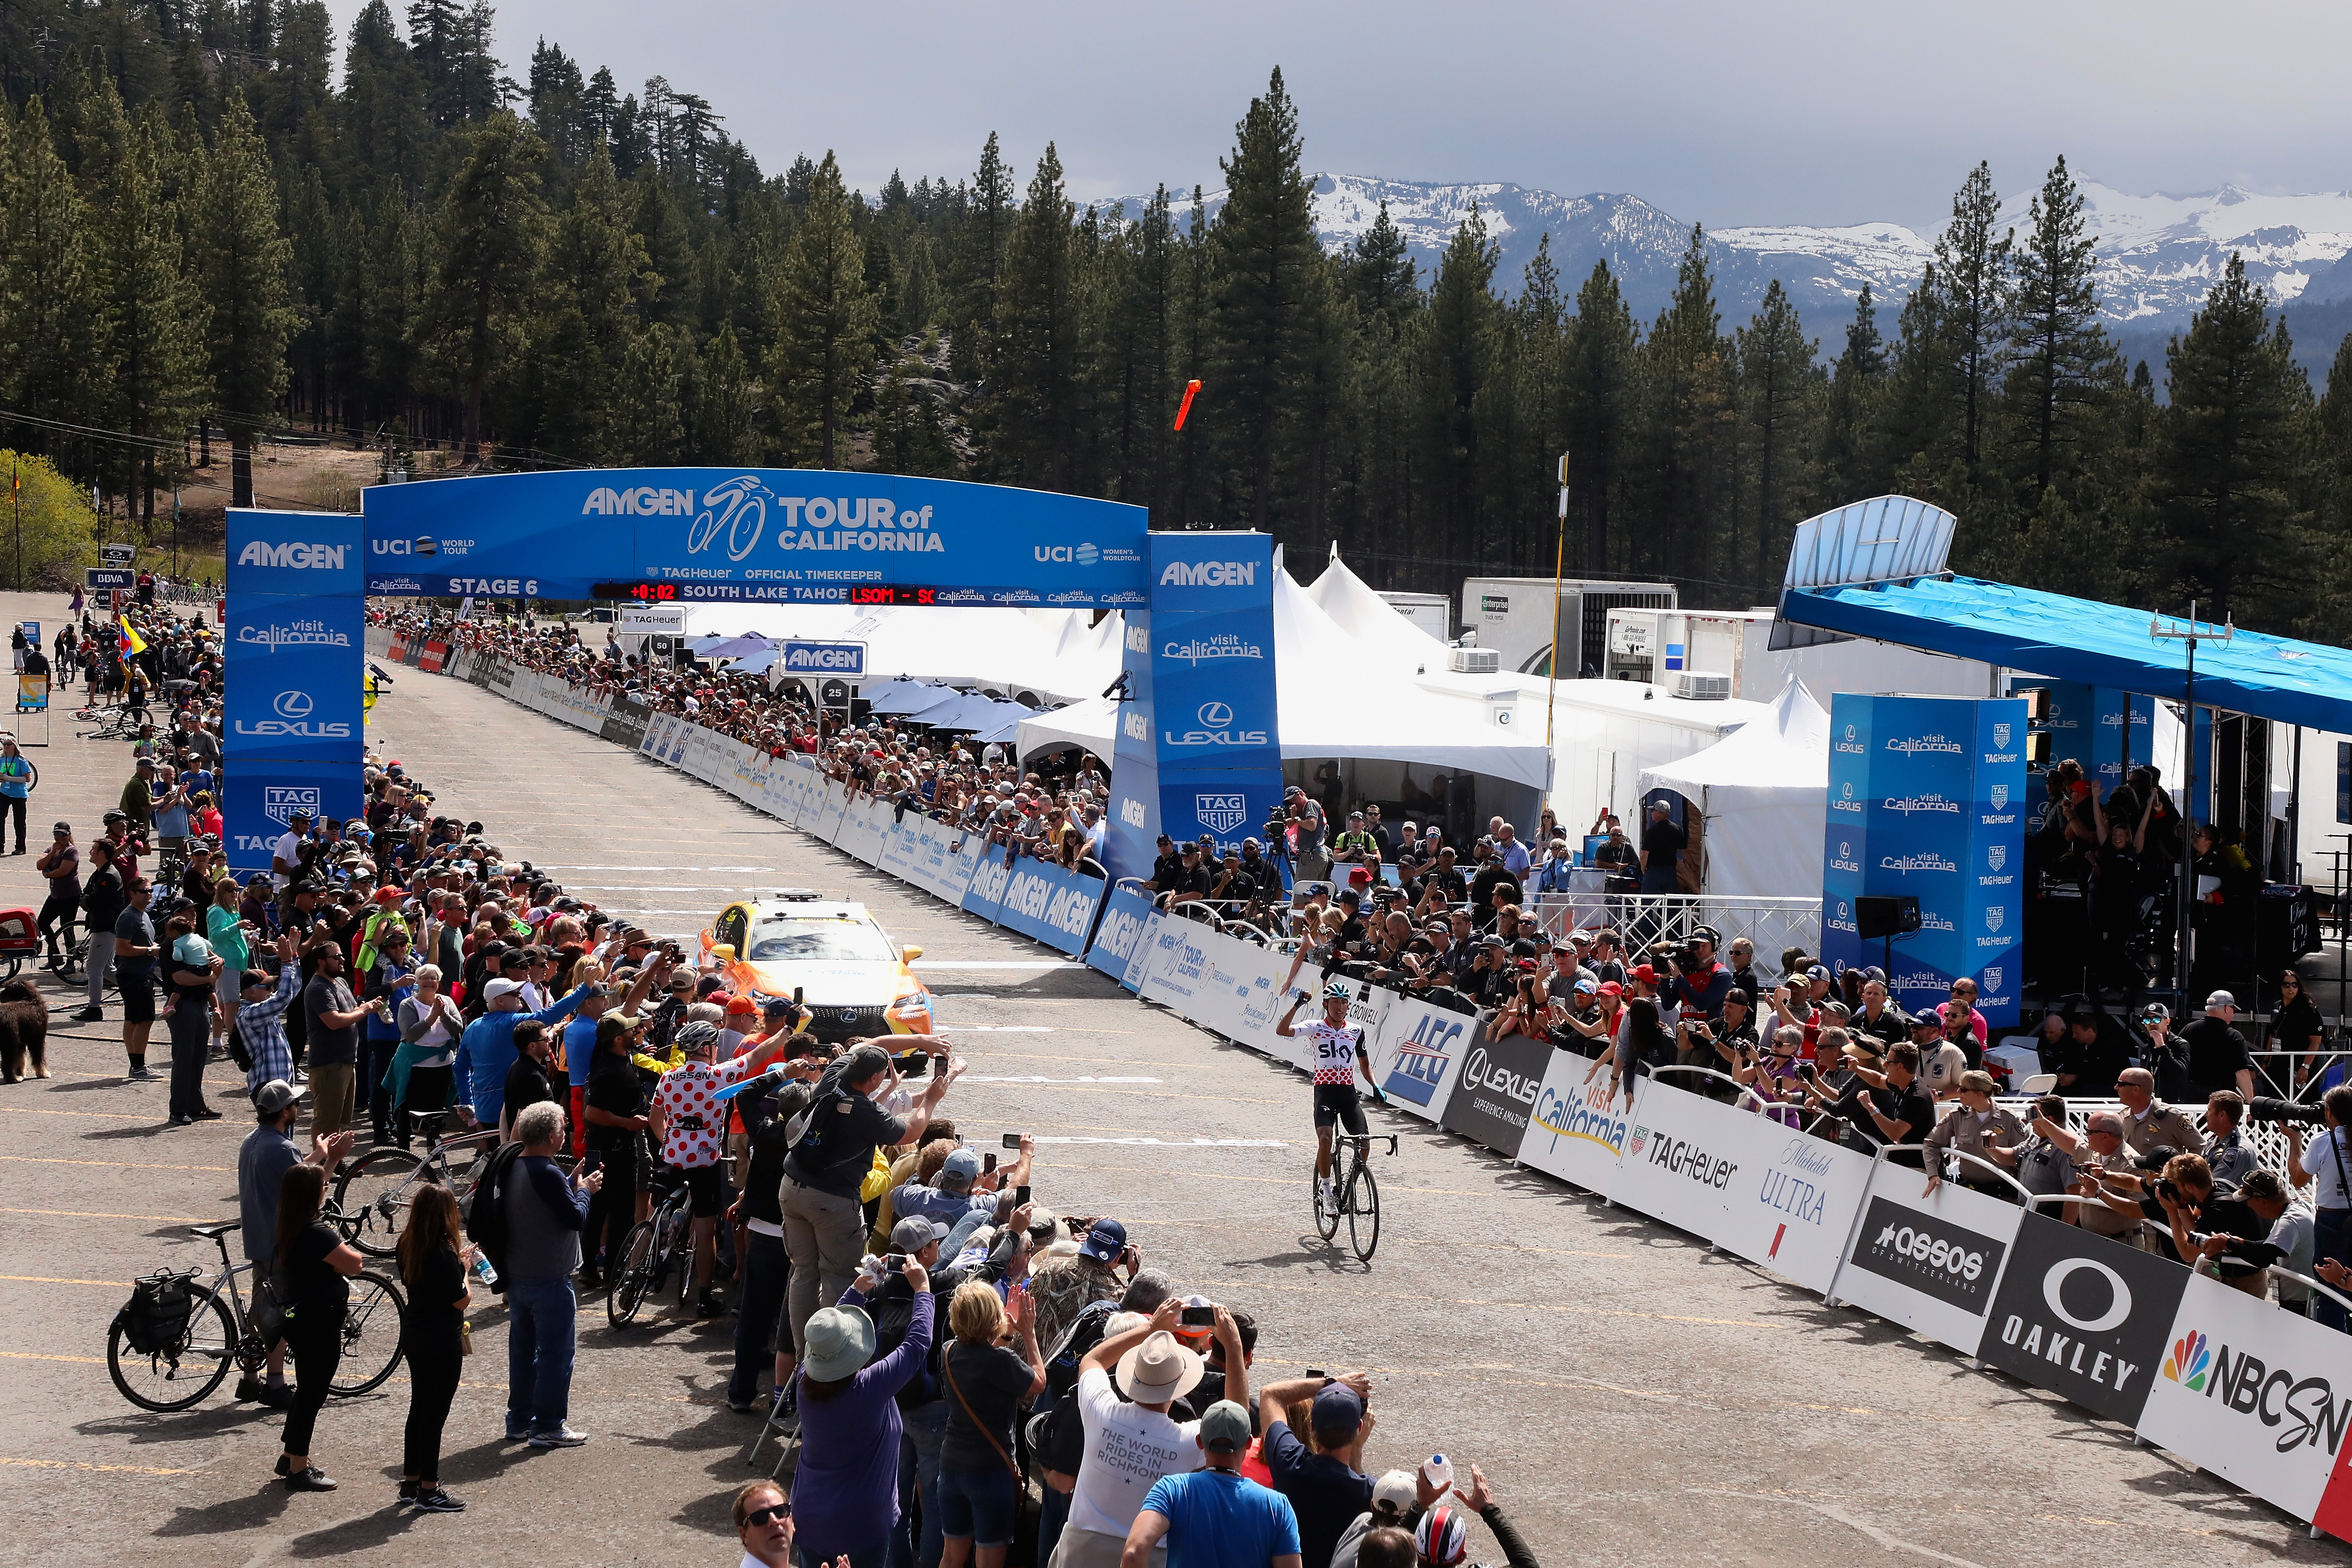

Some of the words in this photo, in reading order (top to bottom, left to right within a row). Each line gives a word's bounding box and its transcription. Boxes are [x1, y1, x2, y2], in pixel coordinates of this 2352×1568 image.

[582, 487, 693, 516] AMGEN
[779, 497, 895, 528] TOUR
[900, 505, 933, 529] of
[373, 539, 411, 555] UCI
[778, 530, 945, 552] CALIFORNIA
[238, 541, 344, 569] AMGEN
[1034, 546, 1072, 562] UCI
[98, 575, 124, 583] BBVA
[662, 567, 732, 578] TAGHeuer
[745, 570, 802, 579] OFFICIAL
[805, 570, 882, 580] TIMEKEEPER
[1160, 561, 1254, 586] AMGEN
[370, 580, 421, 593] California
[449, 578, 519, 594] STAGE
[525, 580, 537, 595] 6
[631, 585, 674, 599] +0:02
[684, 585, 739, 598] SOUTH
[746, 587, 788, 599] LAKE
[794, 587, 847, 599] TAHOE
[852, 587, 894, 603] LSOM
[937, 592, 985, 604] California
[992, 592, 1040, 605] California
[1047, 592, 1094, 605] California
[1100, 594, 1145, 606] California
[1482, 599, 1508, 610] enterprise
[292, 620, 323, 632] visit
[237, 624, 351, 653] California
[1126, 626, 1148, 654] AMGEN
[1210, 634, 1239, 645] visit
[788, 649, 857, 668] AMGEN
[1162, 639, 1263, 666] California
[828, 689, 842, 697] 25
[235, 720, 350, 737] LEXUS
[1124, 711, 1147, 741] AMGEN
[2101, 713, 2148, 729] Califrnia
[1996, 725, 2008, 734] TAG
[1165, 731, 1268, 745] LEXUS
[1923, 734, 1944, 743] visit
[1995, 735, 2009, 748] HEUER
[1835, 742, 1864, 754] LEXUS
[1885, 737, 1963, 757] California
[1984, 753, 2017, 763] TAGHeuer
[270, 790, 314, 803] TAG
[1920, 794, 1942, 802] visit
[1993, 786, 2007, 794] TAG
[1200, 797, 1240, 809] TAG
[1833, 800, 1861, 812] LEXUS
[1883, 796, 1960, 817] California
[1992, 796, 2007, 809] HEUER
[1121, 797, 1145, 829] AMGEN
[1201, 811, 1243, 830] HEUER
[1981, 814, 2015, 825] TAGHeuer
[1917, 852, 1939, 861] visit
[1989, 857, 2005, 870] HEUER
[1830, 859, 1858, 872] LEXUS
[1880, 855, 1957, 875] California
[968, 859, 1010, 904] AMGEN
[1979, 875, 2013, 886] TAGHeuer
[1004, 871, 1051, 920] AMGEN
[1045, 886, 1094, 937] AMGEN
[1921, 912, 1937, 920] isit
[1988, 909, 2002, 917] TAG
[1828, 918, 1856, 932] LEXUS
[1987, 918, 2002, 931] HEUER
[1094, 908, 1141, 960] AMGEN
[1157, 933, 1176, 951] AMGEN
[1976, 936, 2012, 947] TAGHeuer
[1182, 945, 1202, 966] TOUR
[1199, 955, 1207, 968] of
[1212, 969, 1236, 987] BREAKAWAY
[1254, 976, 1271, 990] AMGEN
[1890, 974, 1951, 995] alifornia
[1913, 972, 1935, 981] visit
[1236, 985, 1250, 998] AMGEN
[1288, 986, 1302, 999] AMG
[1985, 979, 2001, 991] HEUER
[1976, 997, 2010, 1008] TAGHeuer
[1244, 1004, 1268, 1024] Breakaway
[1349, 1003, 1379, 1025] CROWELL
[1250, 1020, 1263, 1031] Cancer
[1318, 1040, 1355, 1064] sky
[1394, 1013, 1464, 1087] AEG
[668, 1072, 710, 1082] NISSAN
[1483, 1063, 1540, 1104] LEXUS
[1473, 1097, 1504, 1119] EXPERIENCE
[1502, 1110, 1527, 1128] AMAZING
[1533, 1087, 1627, 1157] California
[1636, 1128, 1647, 1140] TAG
[1630, 1137, 1644, 1155] HEUER
[1649, 1132, 1738, 1190] TAGHeuer
[1780, 1139, 1834, 1176] Michelob
[1760, 1168, 1826, 1226] ULTRA
[1888, 1251, 1976, 1293] SWITZERLAND
[2002, 1314, 2136, 1392] OAKLEY
[2206, 1344, 2352, 1456] NBCSN
[1102, 1427, 1125, 1445] THE
[1128, 1439, 1178, 1461] WORLD
[1105, 1442, 1144, 1464] RIDES
[1147, 1458, 1162, 1470] IN
